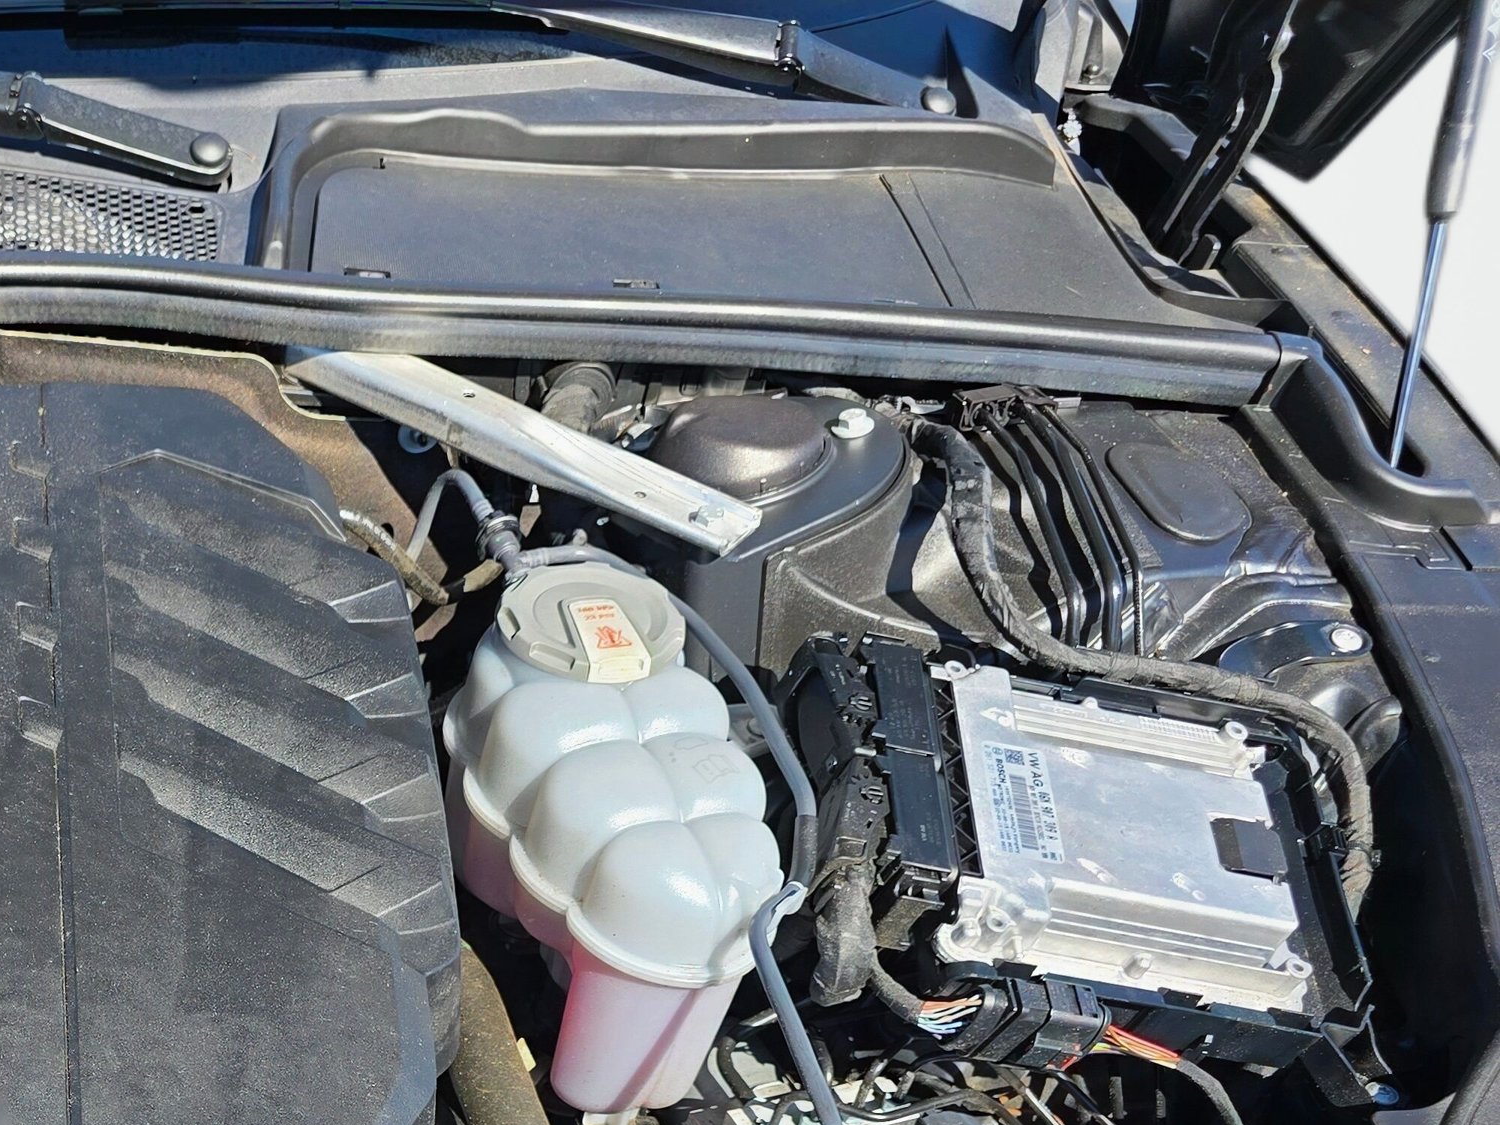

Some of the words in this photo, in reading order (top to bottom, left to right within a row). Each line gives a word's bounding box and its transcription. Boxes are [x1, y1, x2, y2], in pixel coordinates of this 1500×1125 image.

[995, 758, 1007, 784] BOSCH
[1028, 752, 1041, 771] VW
[1031, 770, 1044, 788] AG
